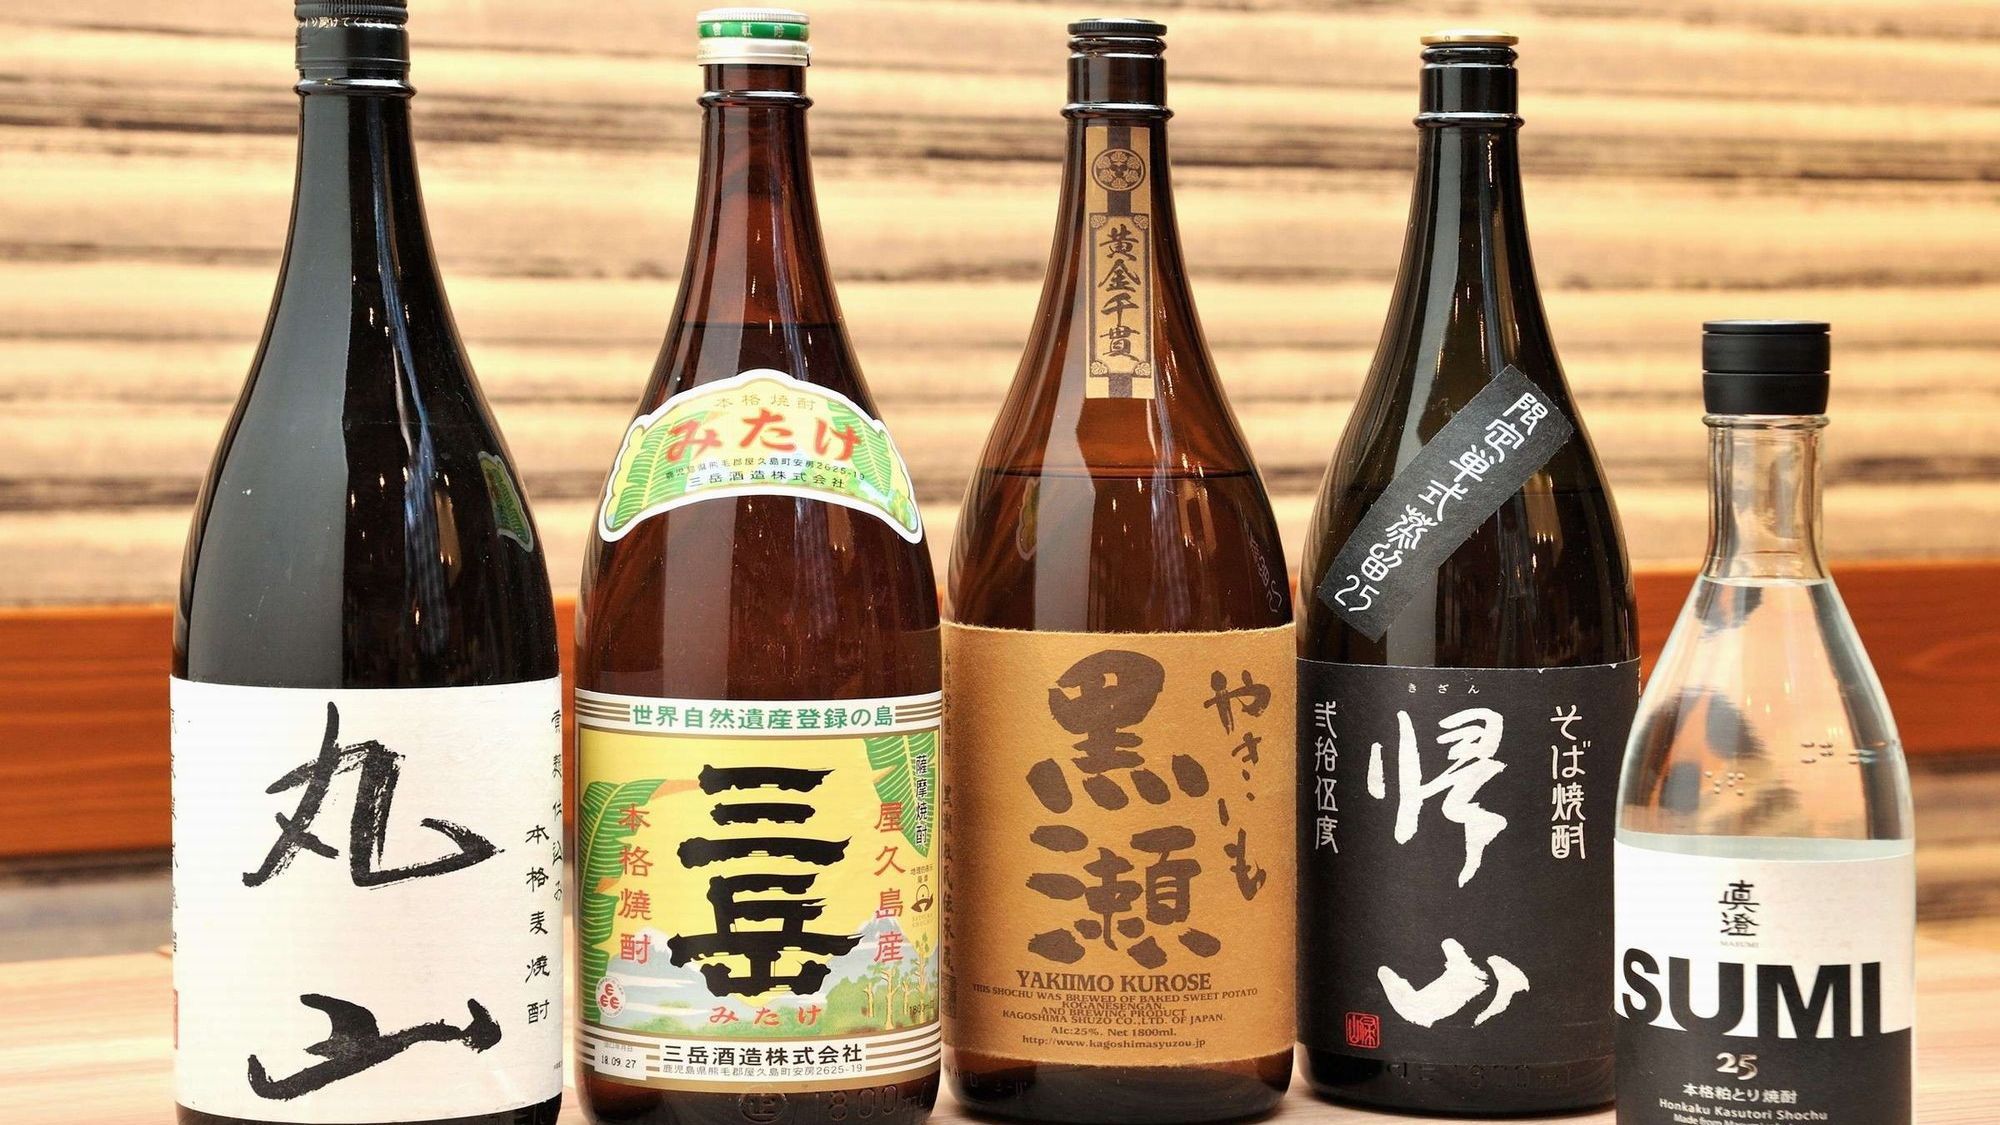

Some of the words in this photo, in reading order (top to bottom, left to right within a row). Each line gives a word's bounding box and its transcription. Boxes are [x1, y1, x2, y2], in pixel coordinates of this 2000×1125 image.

[1099, 223, 1140, 362] 黄金千貫
[666, 407, 863, 463] みたけ
[690, 470, 845, 489] 三岳酒造株式会社
[1407, 682, 1480, 695] きざん
[632, 705, 894, 731] 世界自然遺産登録の島
[1203, 670, 1272, 901] やきいも
[1550, 704, 1592, 860] そば焼酎
[915, 754, 928, 844] 薩摩焼酎
[1025, 649, 1221, 970] 黒瀬
[666, 763, 864, 998] 三岳
[873, 801, 907, 965] 屋久島産
[241, 701, 506, 1102] 丸山
[1718, 879, 1760, 936] 真澄
[972, 983, 990, 993] THIS
[992, 986, 1033, 999] SHOCHU
[1036, 991, 1062, 1001] WAS
[1066, 994, 1116, 1003] BREWED
[1120, 995, 1136, 1003] OF
[1140, 994, 1180, 1003] BAKED
[1183, 992, 1219, 1002] SWEET
[1222, 987, 1258, 999] POTATO
[1016, 970, 1115, 992] YAKIIMO
[1120, 973, 1212, 993] KUROSE
[1622, 947, 1881, 1038] SUMI
[709, 1006, 822, 1026] みたけ
[1002, 1009, 1067, 1023] KAGOSHIMA
[1071, 1016, 1112, 1025] SHUZO
[1171, 1015, 1187, 1024] OF
[1041, 1006, 1066, 1016] AND
[1069, 1008, 1127, 1017] BREWING
[1130, 1009, 1187, 1017] PRODUCT
[1062, 1000, 1166, 1010] KOGANESENGAN.
[1022, 1034, 1206, 1050] http://www.kagoshimasyuzou.jp
[1108, 1028, 1128, 1037] Net
[1132, 1027, 1177, 1037] 1800ml.
[663, 1044, 863, 1066] 三岳酒造株式会社
[1716, 1052, 1758, 1081] 25
[1682, 1082, 1798, 1104] 本格粕とり焼酎
[1659, 1098, 1711, 1115] Honkaku
[1714, 1106, 1772, 1120] Kasutori
[1776, 1109, 1829, 1121] Shochu
